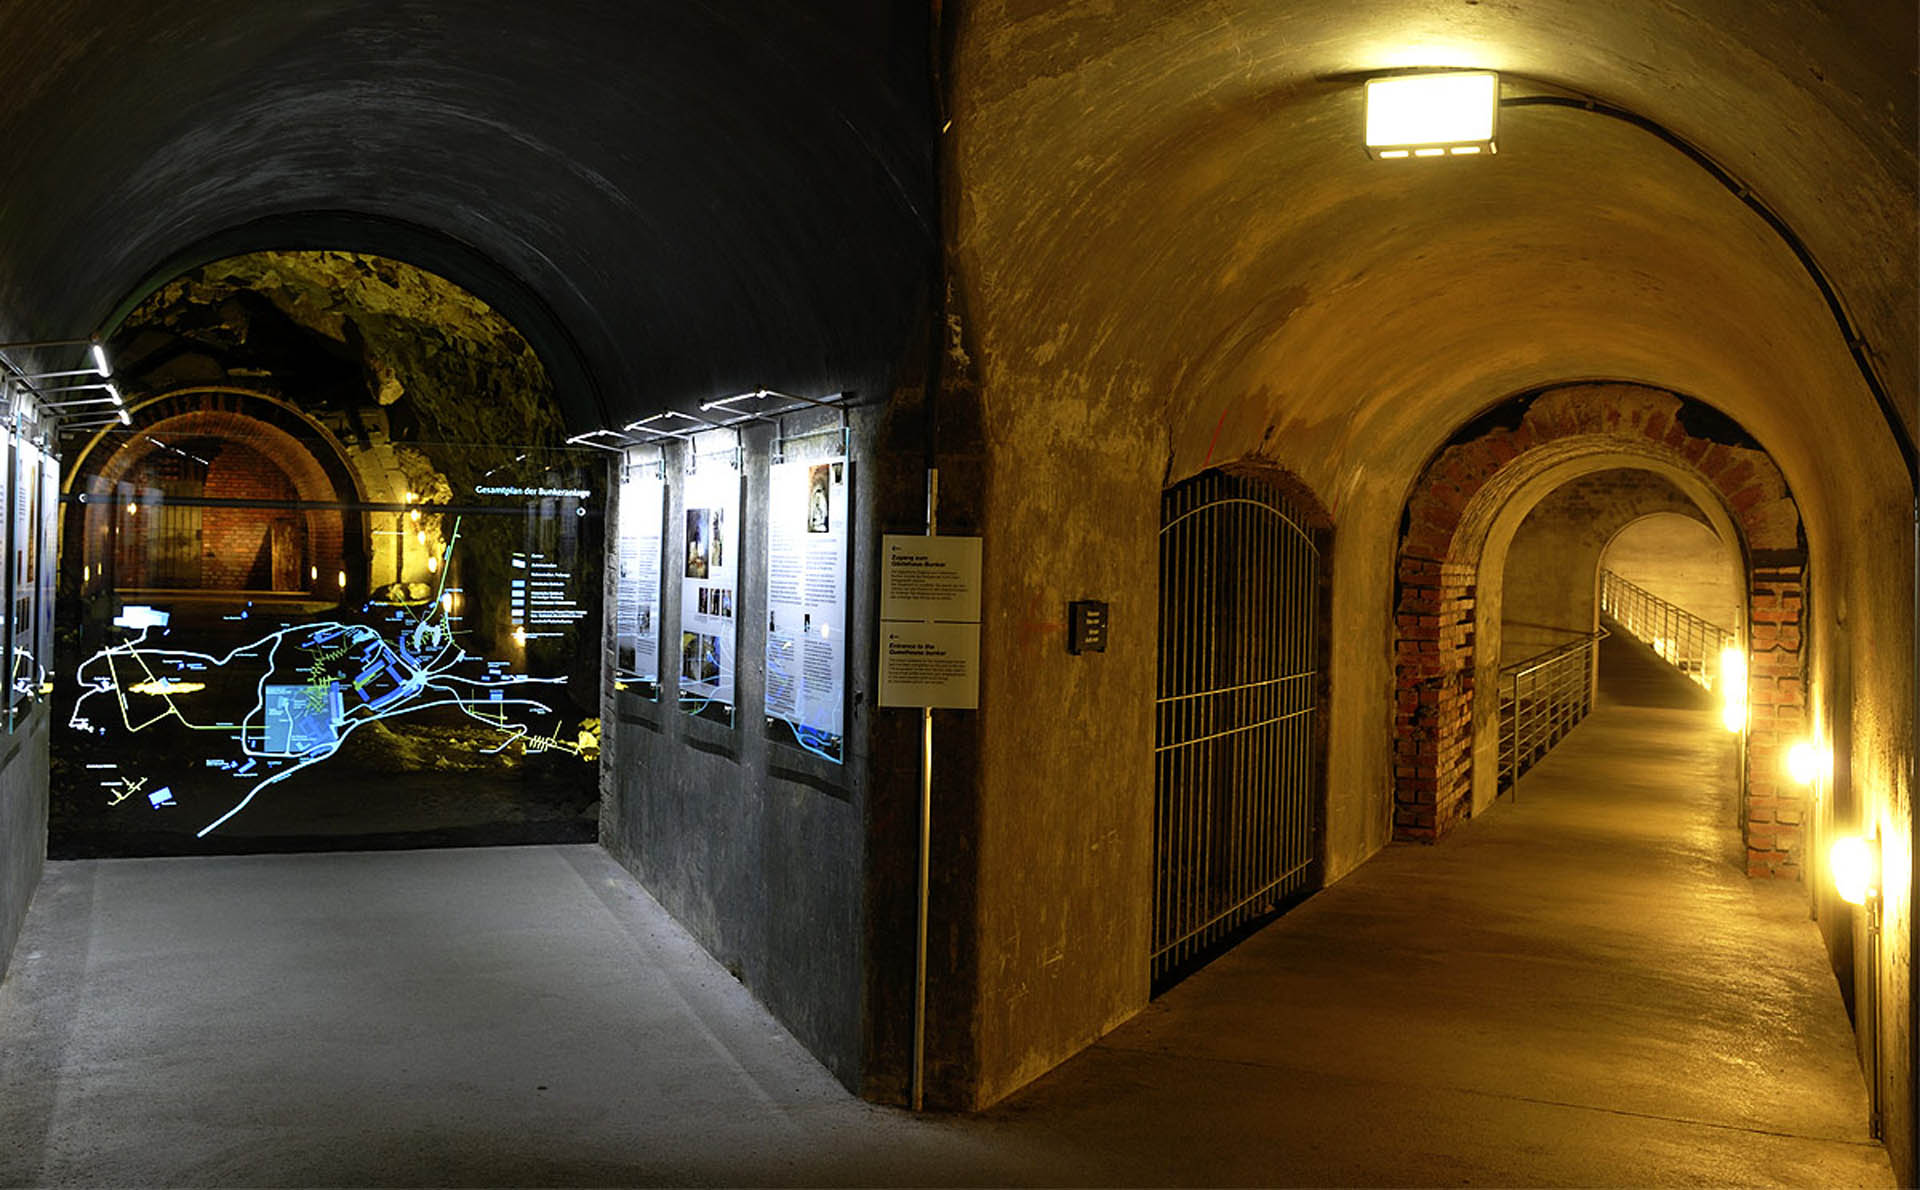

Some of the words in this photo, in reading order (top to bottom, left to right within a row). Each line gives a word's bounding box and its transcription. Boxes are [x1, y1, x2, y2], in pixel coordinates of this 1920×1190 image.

[475, 485, 523, 497] Gesamtplan
[524, 487, 537, 496] der
[538, 487, 591, 499] Bunkeranlage
